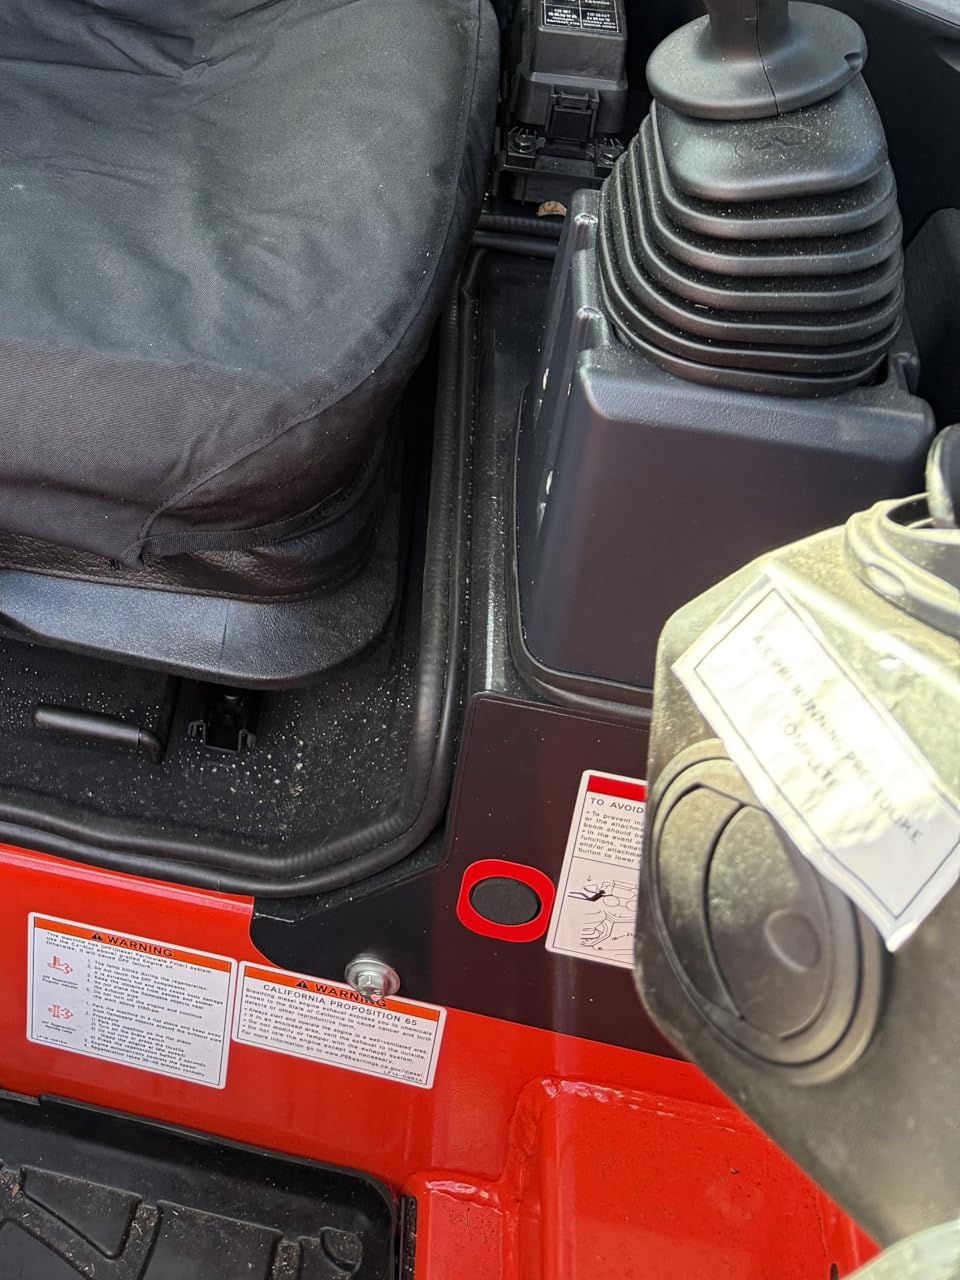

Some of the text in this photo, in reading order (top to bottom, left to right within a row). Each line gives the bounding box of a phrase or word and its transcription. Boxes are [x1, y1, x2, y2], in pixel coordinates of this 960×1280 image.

[589, 797, 644, 814] TO AVOID
[106, 935, 174, 958] WARNING
[263, 984, 417, 1026] CALIFORNIA PROPOSITION 65
